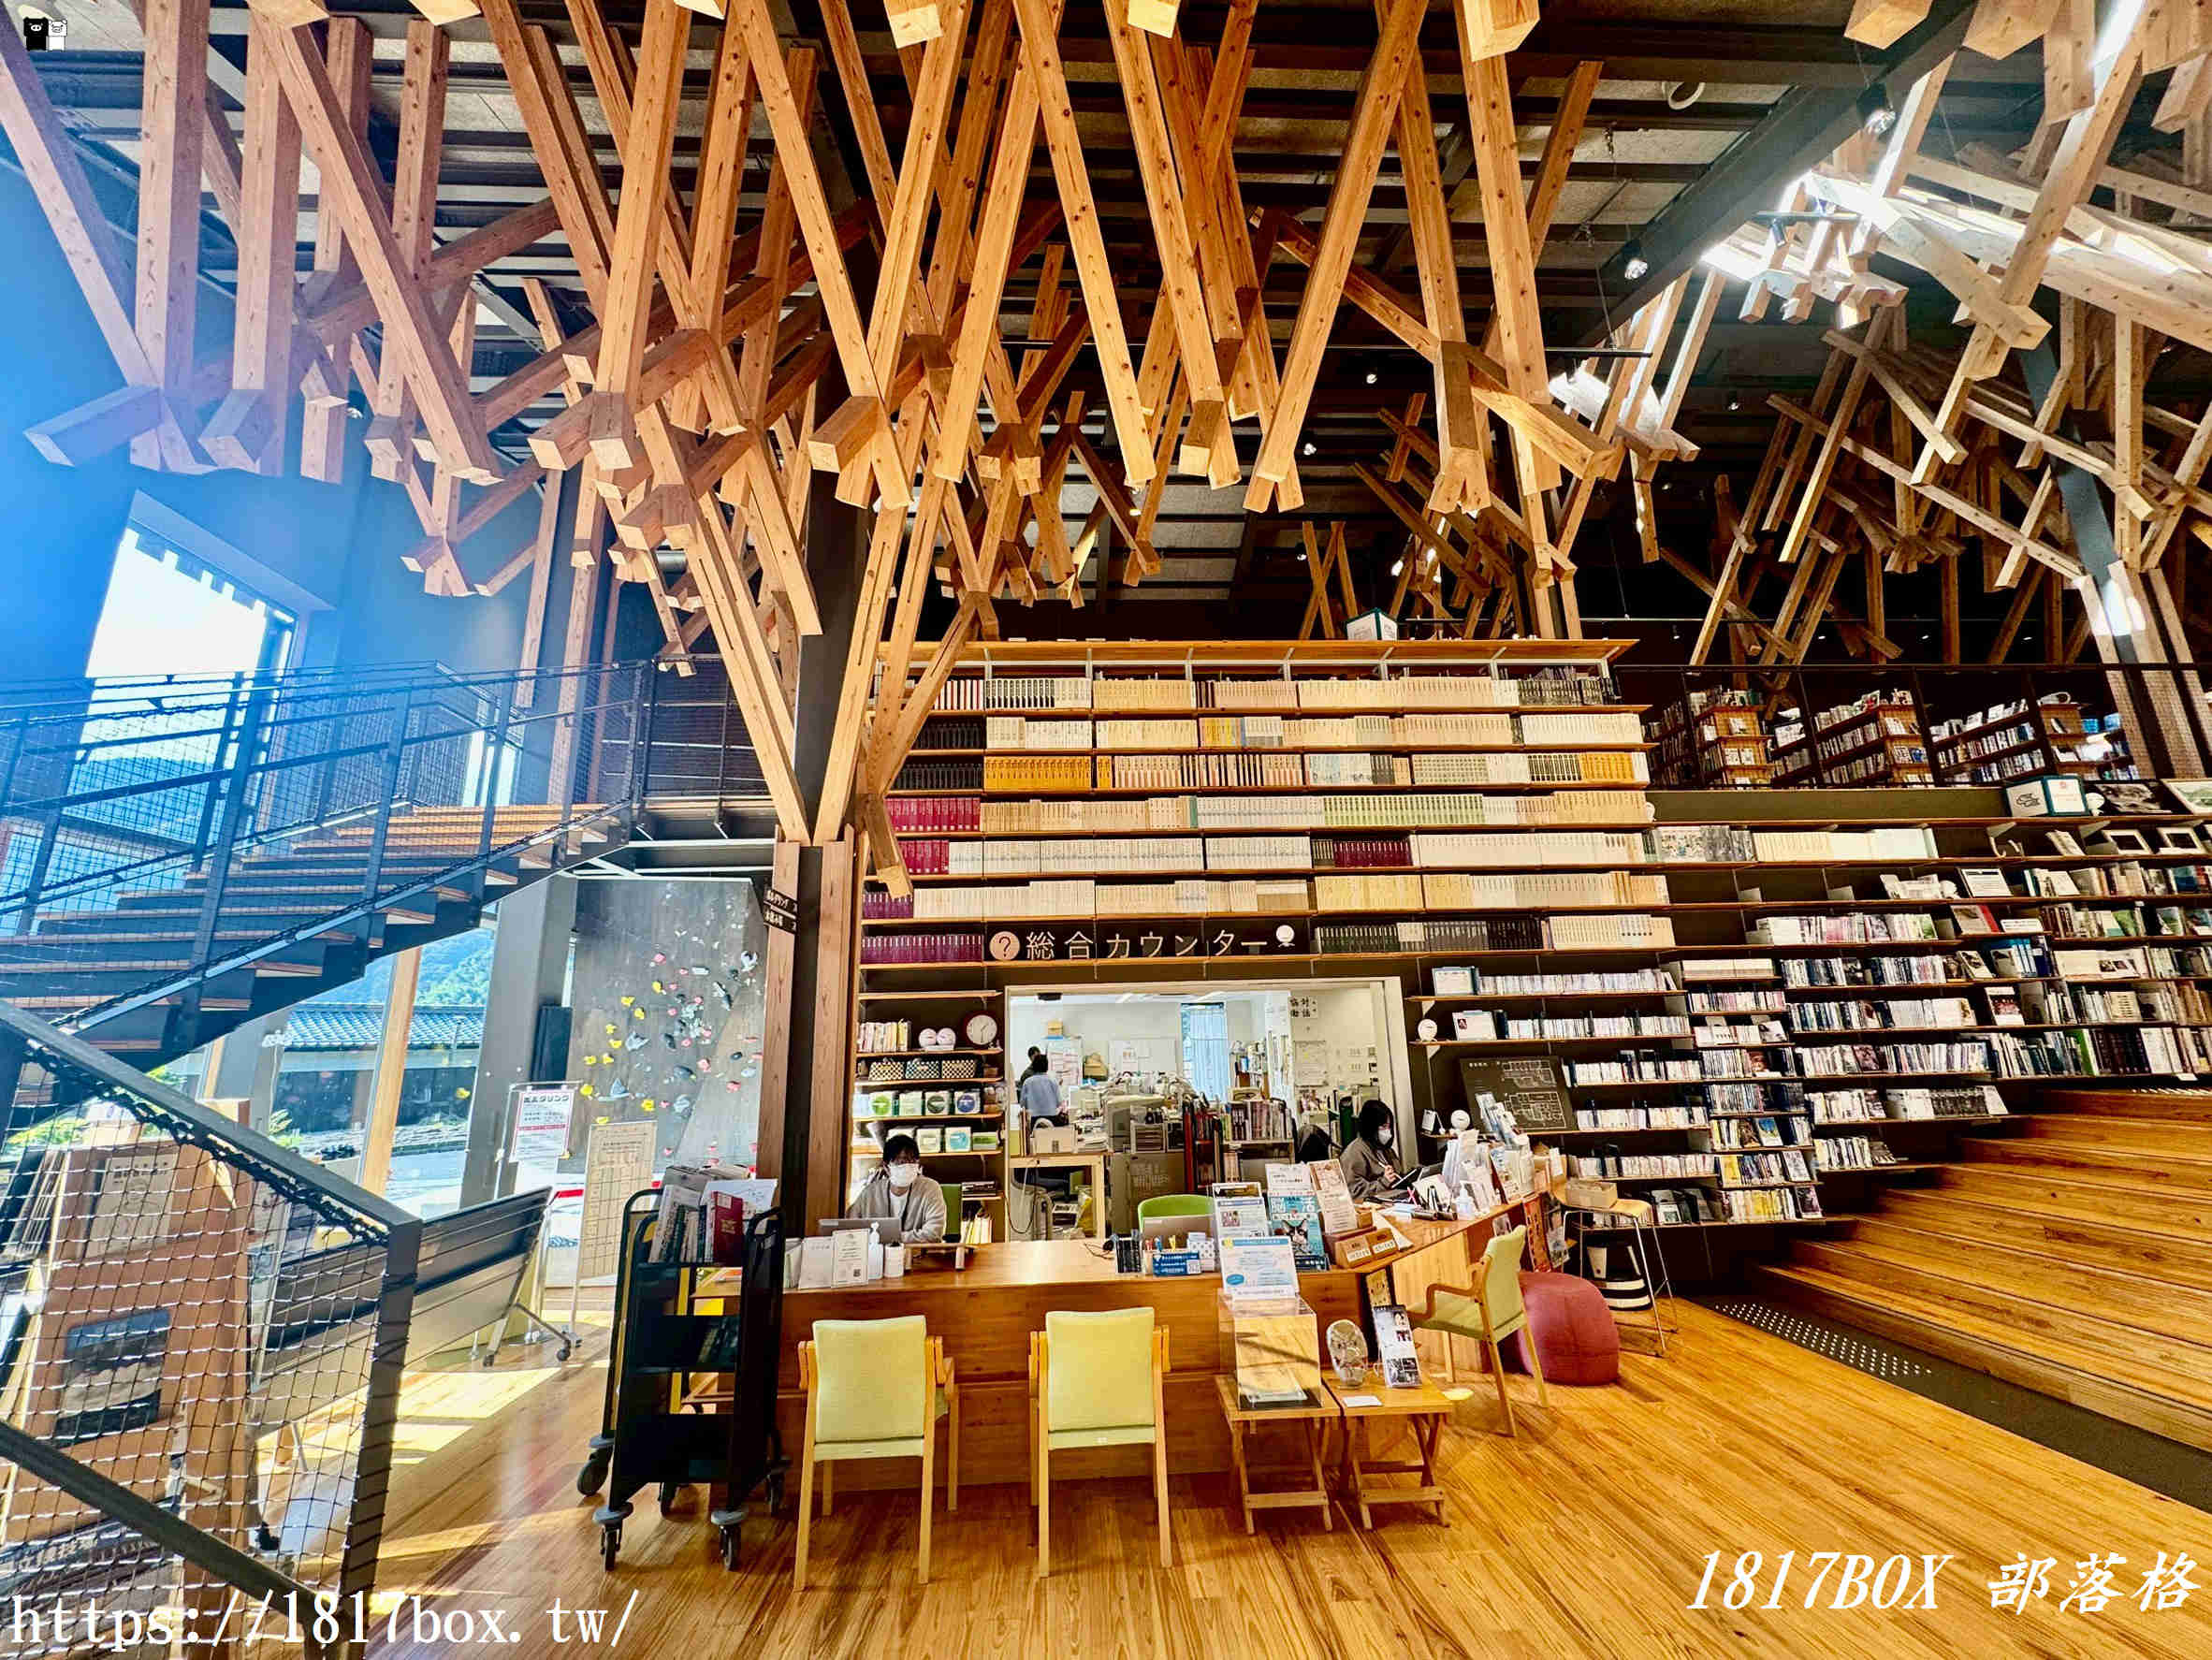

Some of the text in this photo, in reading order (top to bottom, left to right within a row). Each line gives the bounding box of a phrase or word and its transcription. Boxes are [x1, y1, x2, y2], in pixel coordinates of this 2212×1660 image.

[1026, 929, 1268, 961] 総合カウンター
